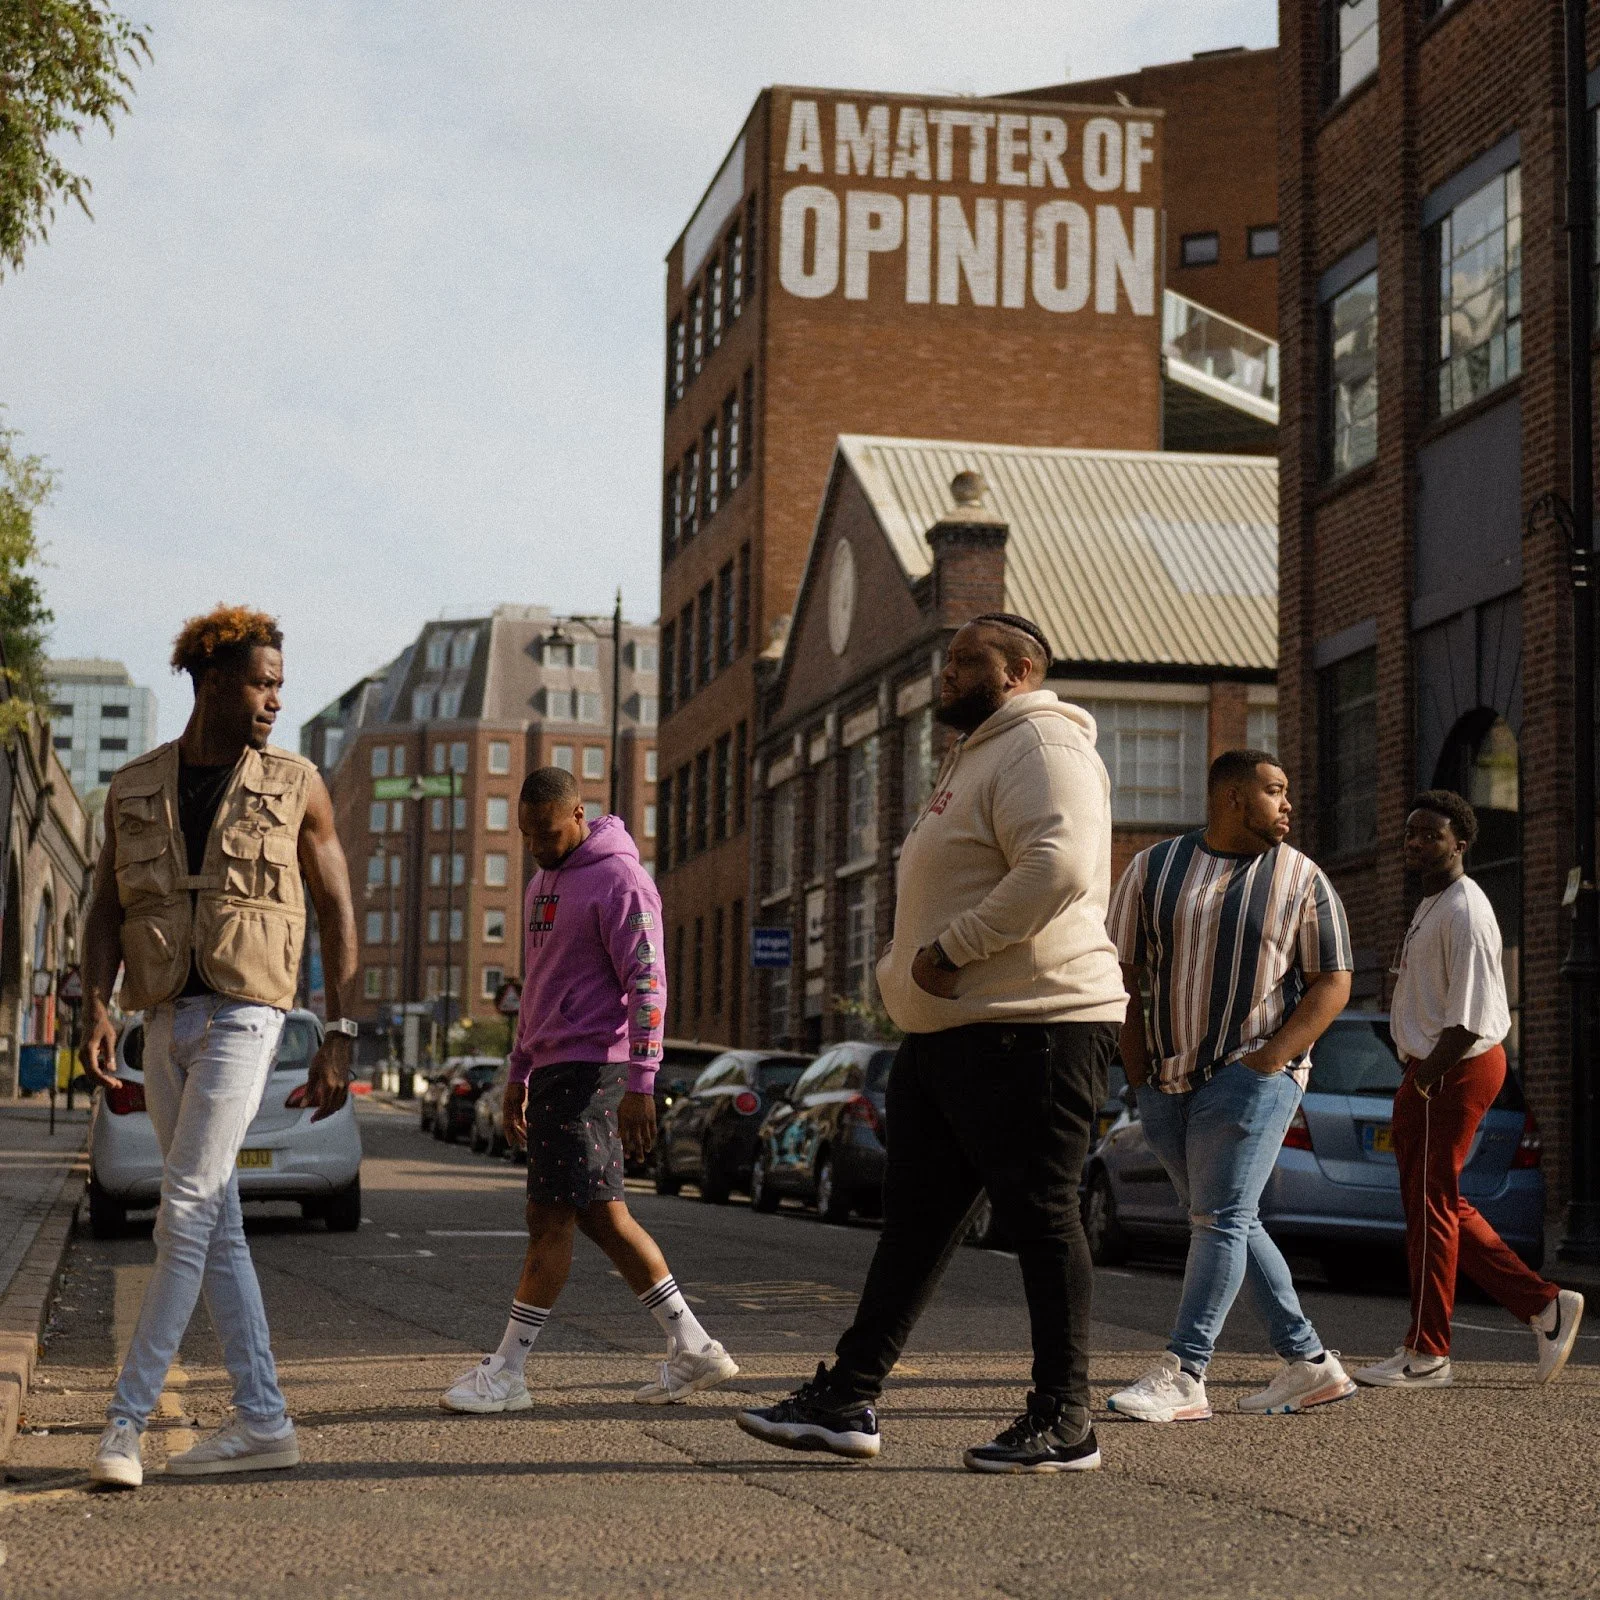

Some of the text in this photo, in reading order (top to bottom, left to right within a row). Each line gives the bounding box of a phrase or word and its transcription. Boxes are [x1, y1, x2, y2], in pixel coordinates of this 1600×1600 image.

[783, 100, 1155, 193] A MATTER OF
[778, 185, 1156, 316] OPINION
